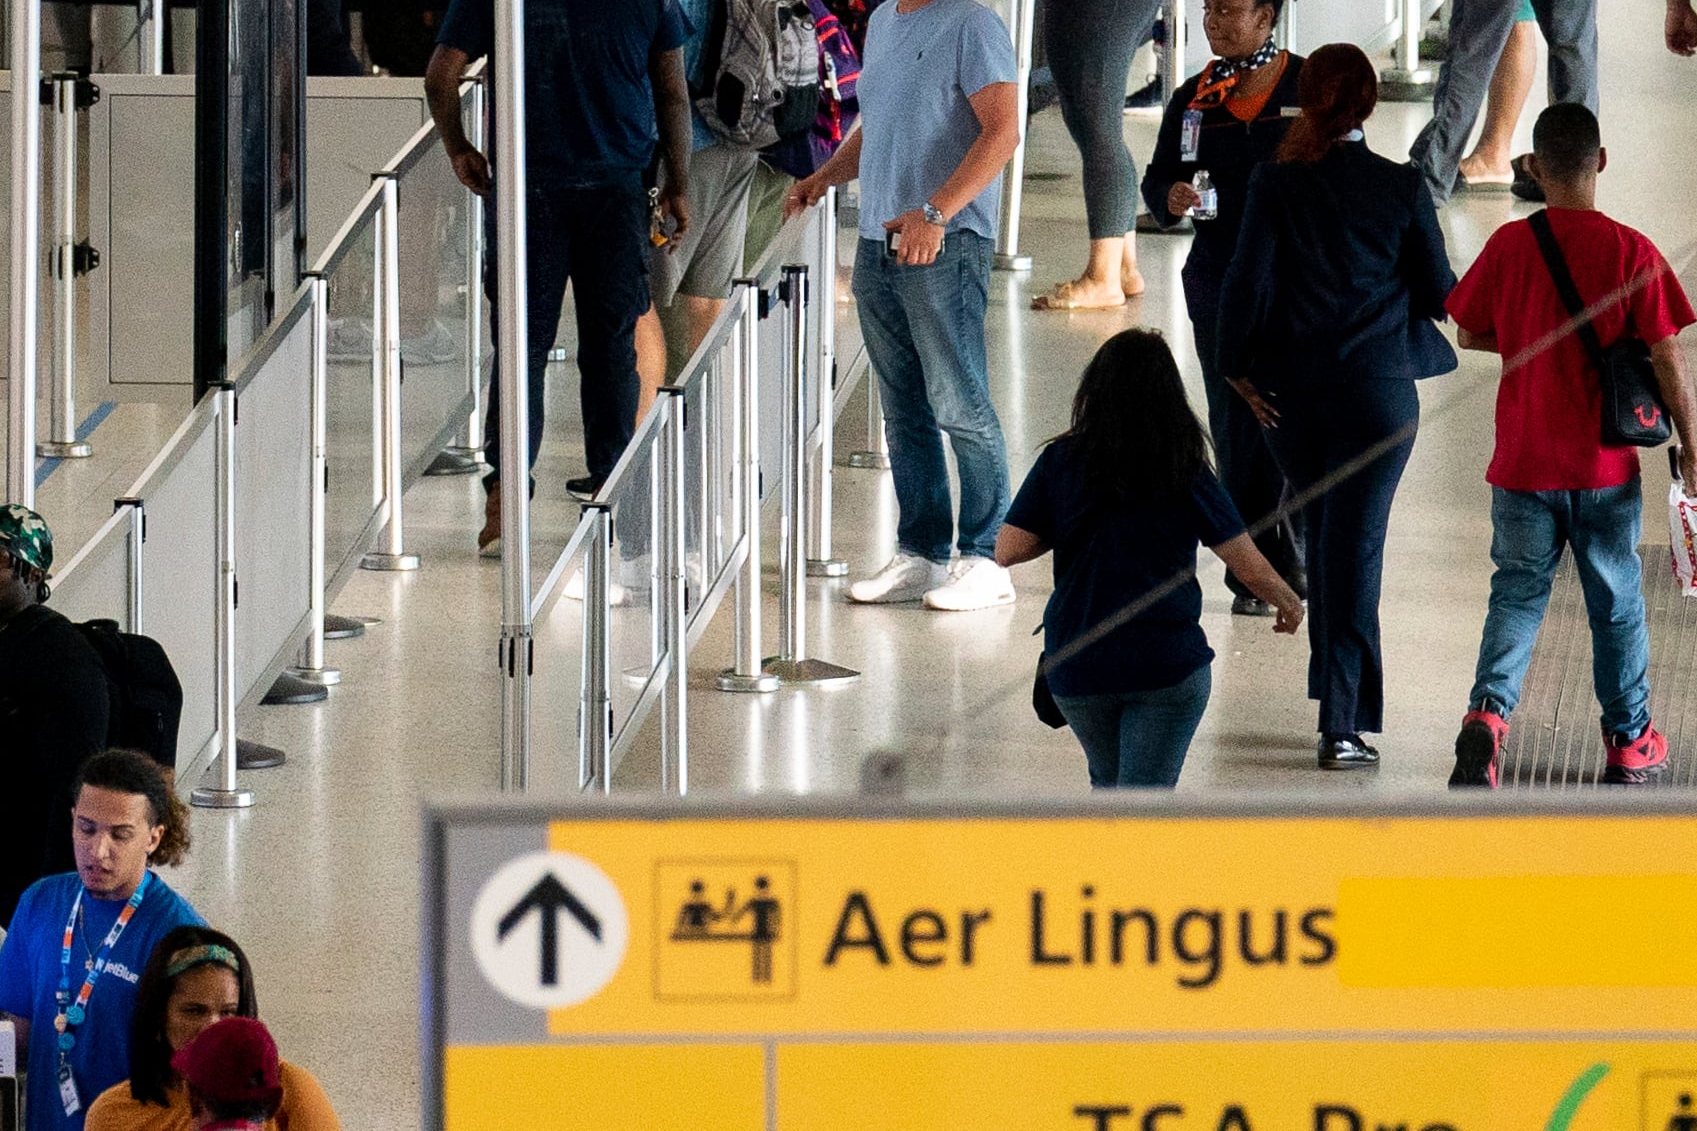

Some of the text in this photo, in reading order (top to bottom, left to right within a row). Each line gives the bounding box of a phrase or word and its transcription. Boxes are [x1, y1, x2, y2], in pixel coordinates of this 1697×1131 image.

[822, 884, 1339, 990] Aer Lingus
[103, 959, 140, 985] jetBlue
